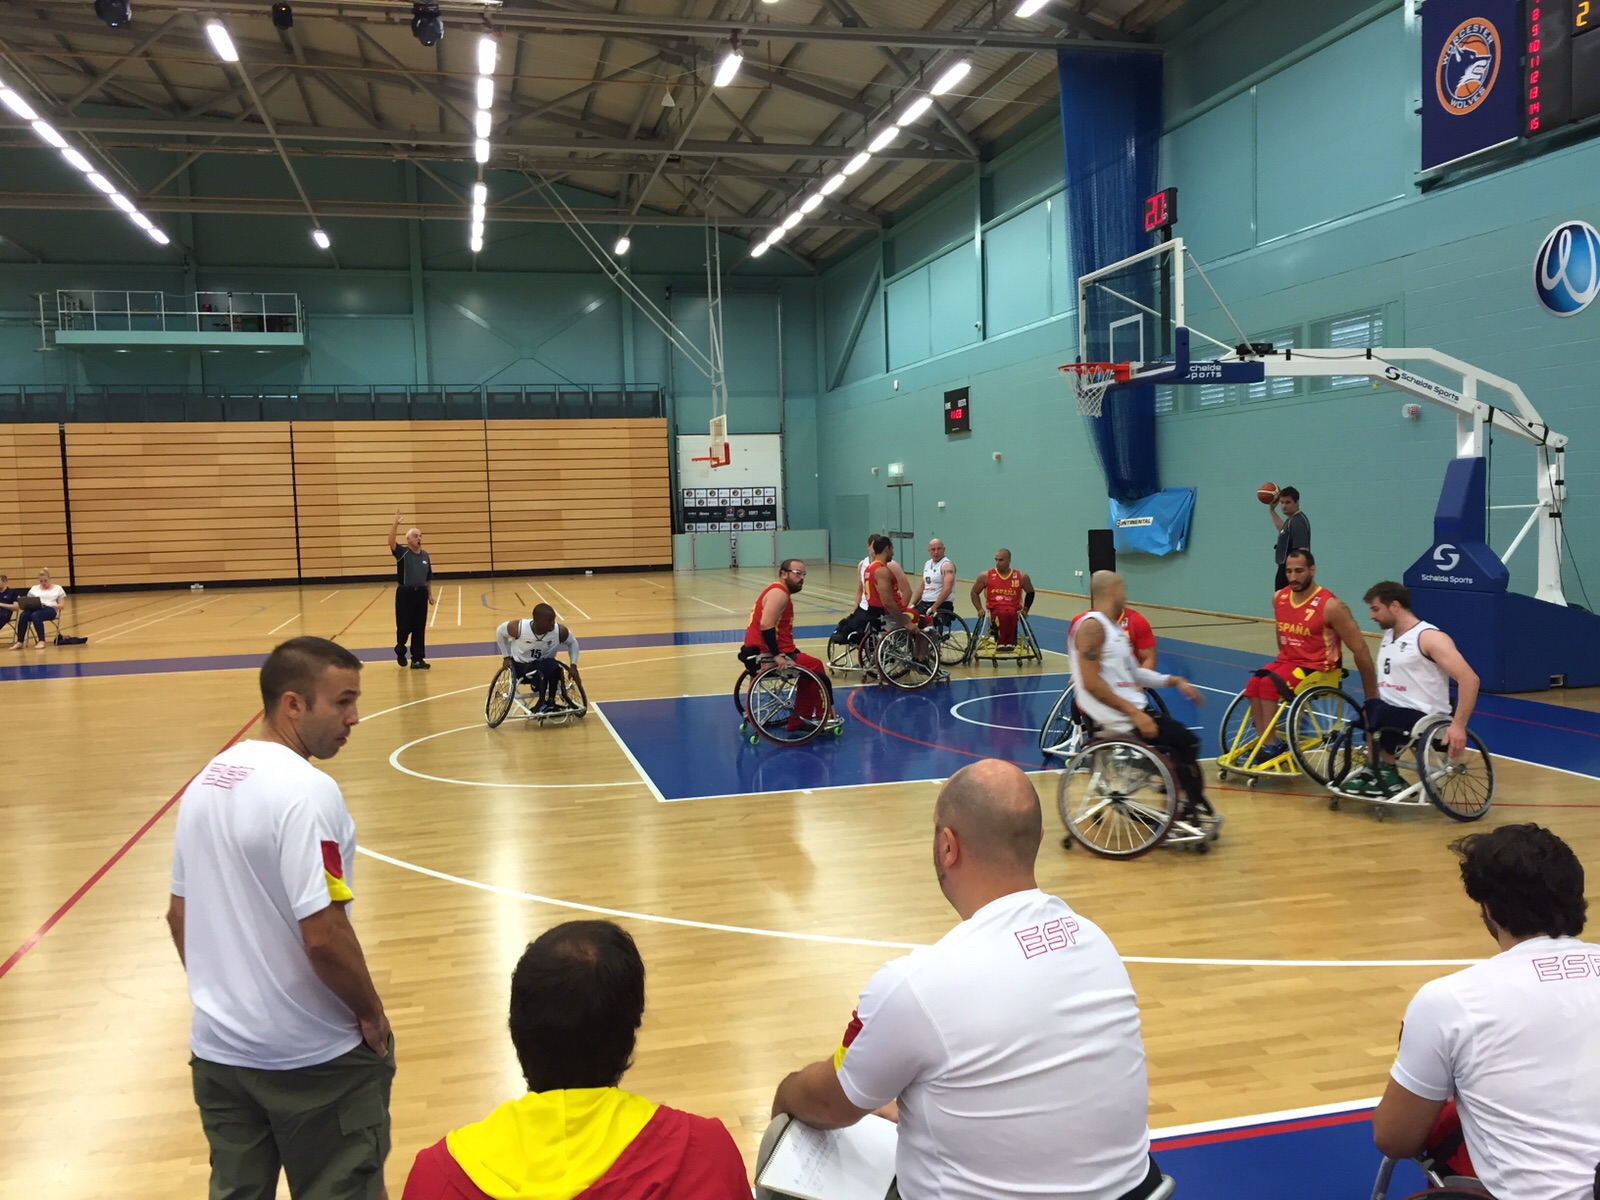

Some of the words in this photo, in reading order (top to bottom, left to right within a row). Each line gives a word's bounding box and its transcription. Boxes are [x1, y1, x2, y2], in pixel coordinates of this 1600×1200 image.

[1531, 8, 1540, 21] 8
[1576, 1, 1590, 27] 2
[1531, 24, 1539, 37] 9
[1442, 24, 1494, 65] WORCESTER
[1528, 39, 1540, 53] 10
[1530, 55, 1540, 68] 11
[1530, 70, 1539, 84] 12
[1450, 86, 1486, 109] WOLVES
[1529, 86, 1539, 99] 13
[1529, 101, 1540, 115] 14
[1530, 116, 1539, 130] 15
[1144, 191, 1165, 229] 20
[1401, 373, 1433, 391] Schelde
[1433, 386, 1460, 402] Sports
[1421, 573, 1449, 583] Schelde
[1449, 575, 1473, 585] Sports
[1304, 608, 1316, 621] 7
[530, 648, 542, 659] 15
[1383, 657, 1391, 675] 5
[1014, 915, 1080, 960] ESP
